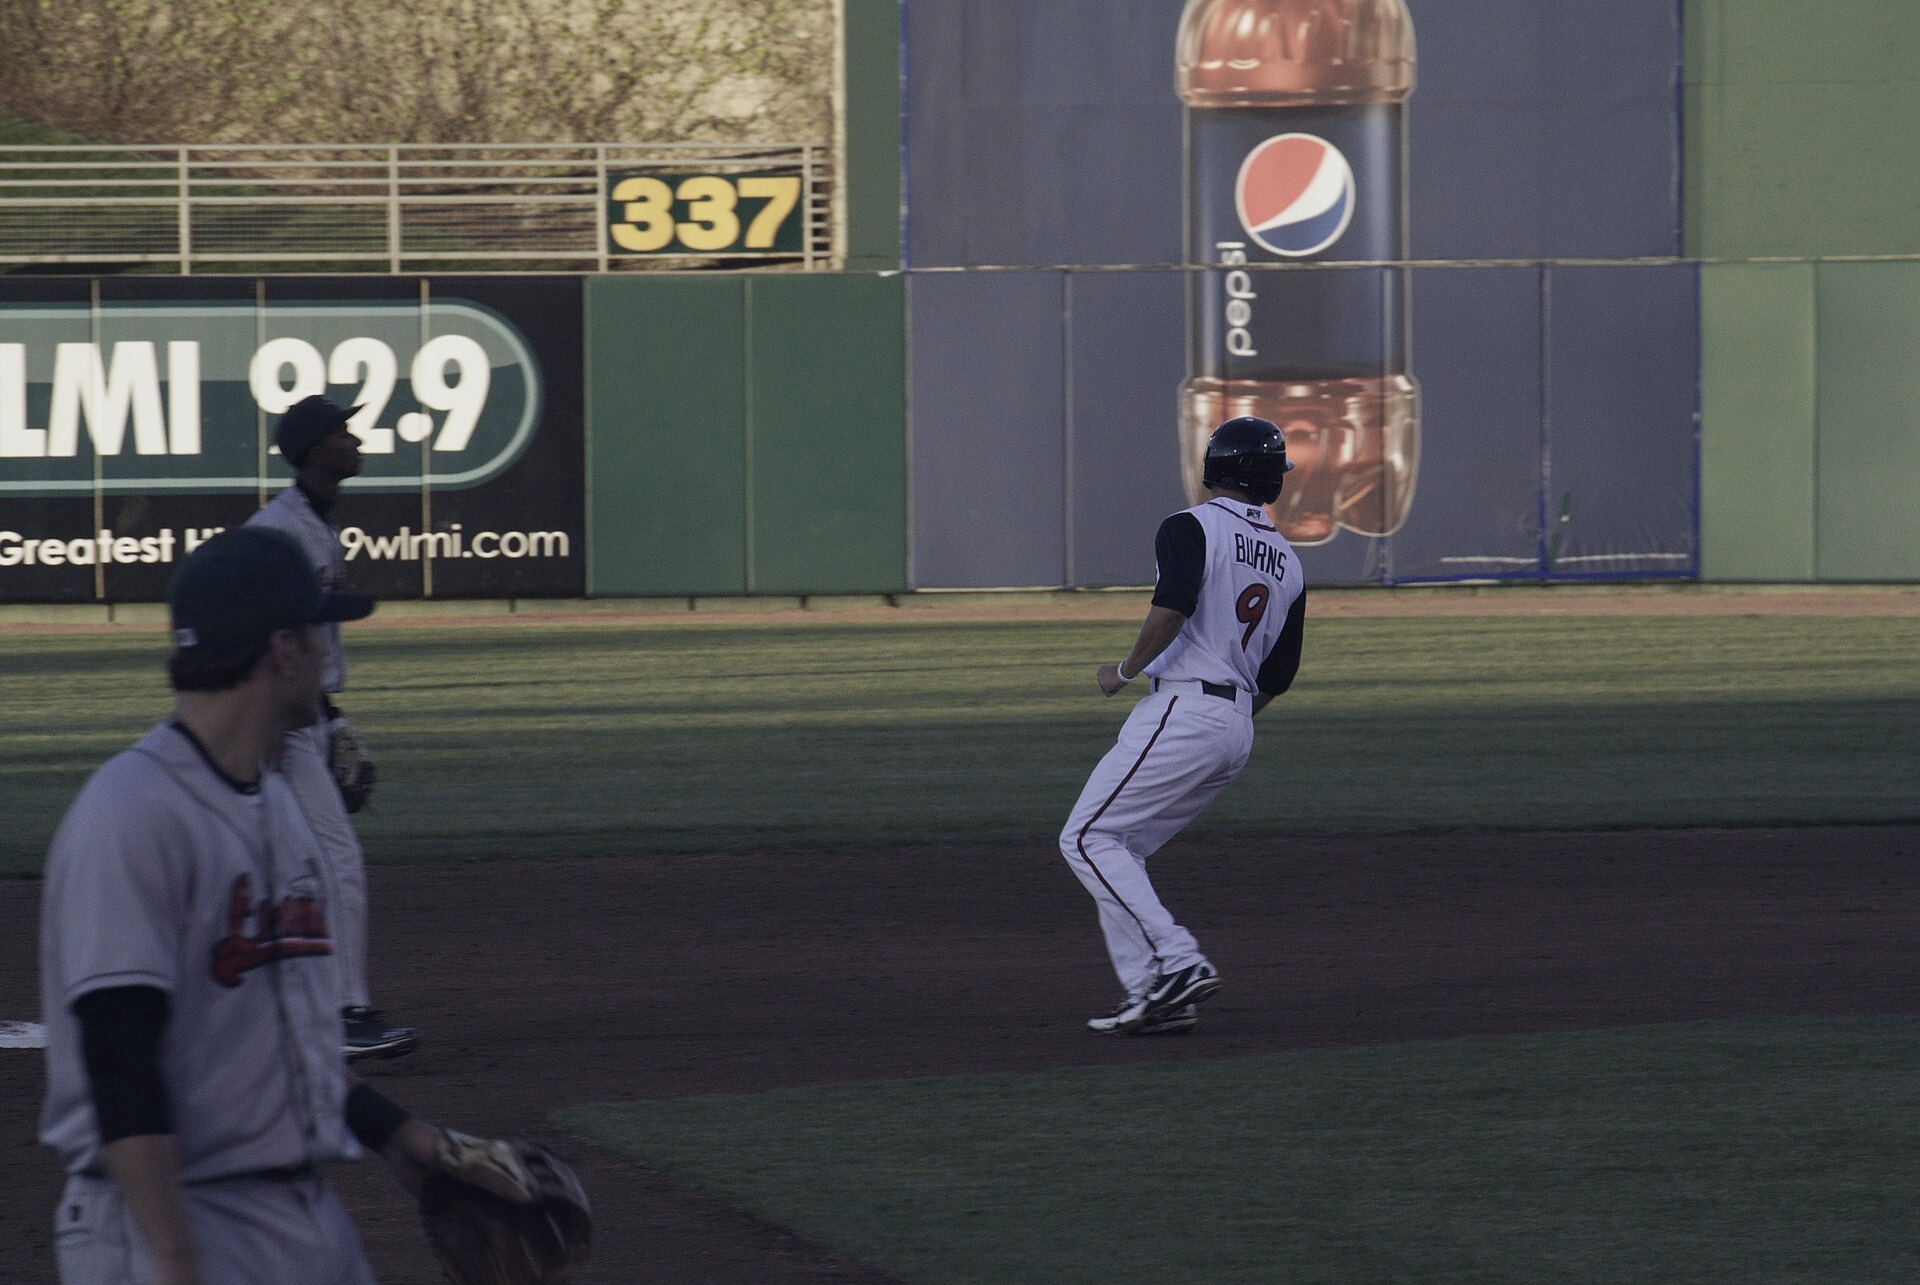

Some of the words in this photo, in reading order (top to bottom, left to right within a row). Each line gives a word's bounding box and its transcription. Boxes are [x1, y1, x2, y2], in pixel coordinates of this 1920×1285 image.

[610, 176, 801, 252] 337
[1215, 241, 1257, 356] pepsi
[0, 340, 200, 458] LMI
[248, 334, 491, 455] 92.9
[0, 528, 176, 566] Greatest
[1234, 532, 1288, 583] BURNS
[1235, 582, 1270, 654] 9
